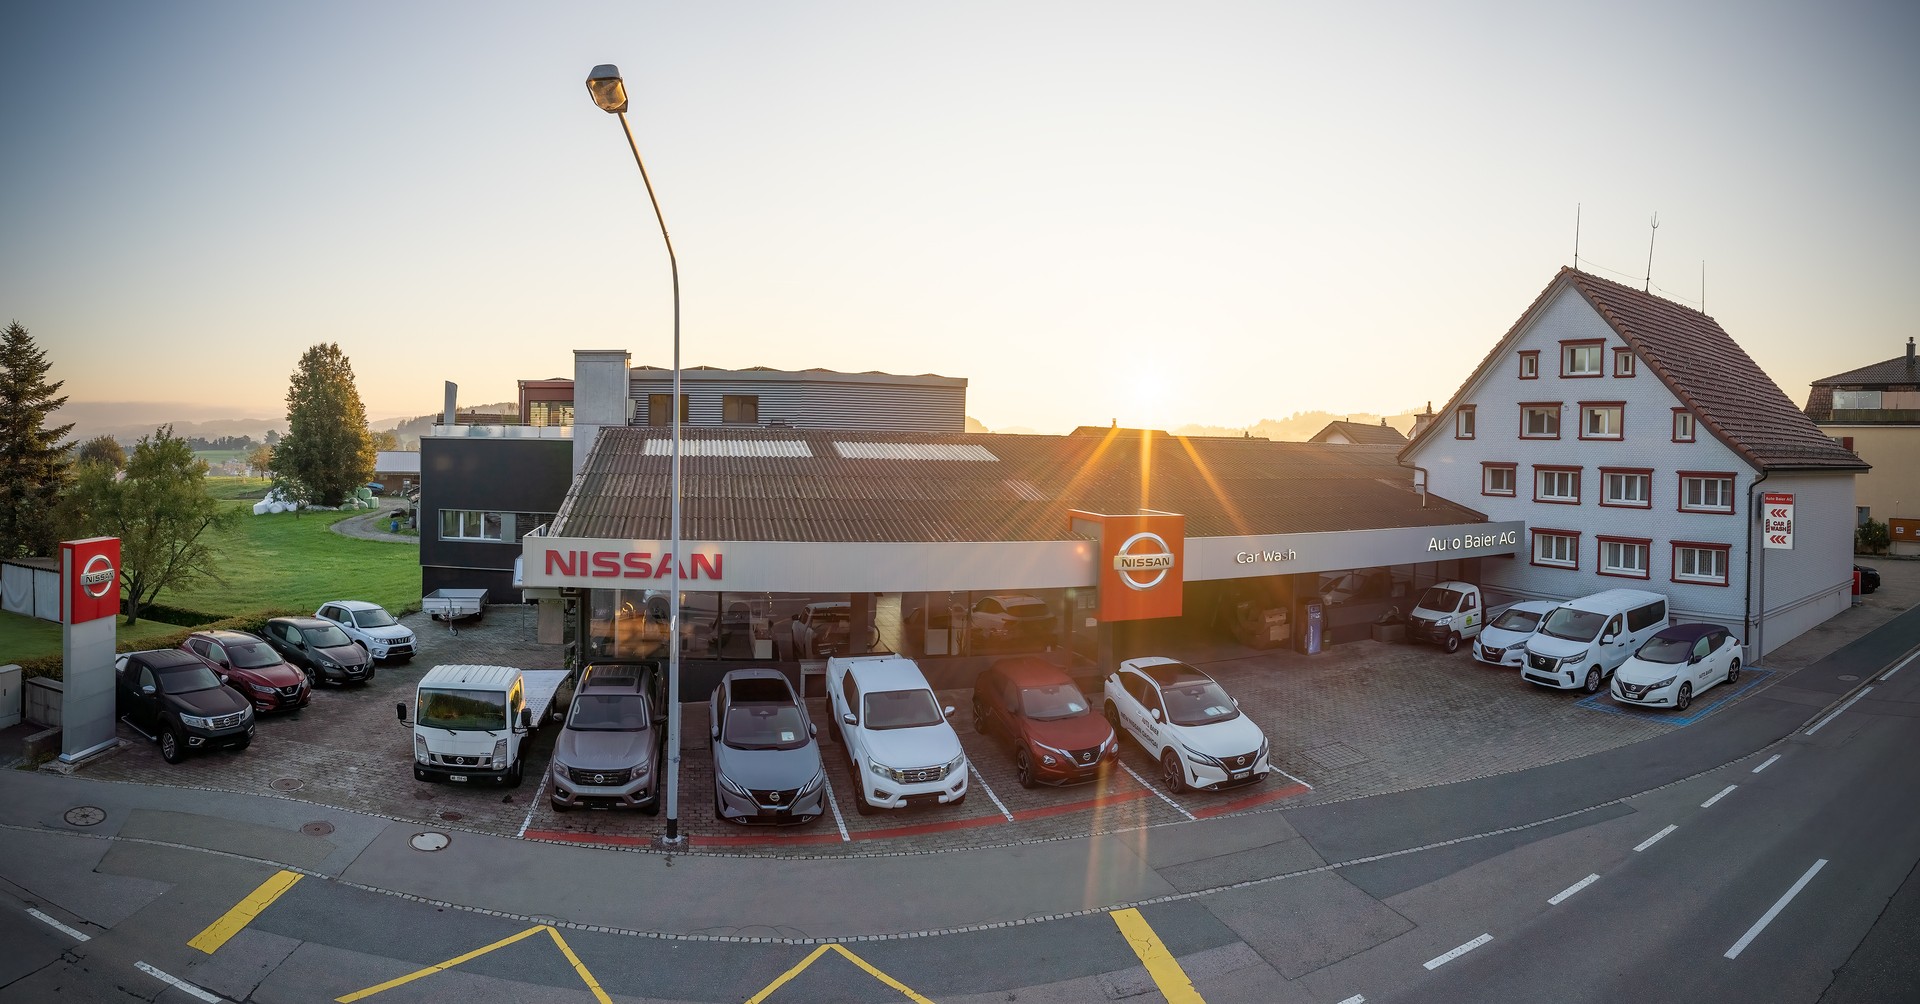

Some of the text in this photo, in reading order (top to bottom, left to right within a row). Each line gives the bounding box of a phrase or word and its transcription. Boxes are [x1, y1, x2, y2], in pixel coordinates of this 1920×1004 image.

[1427, 530, 1516, 552] Auto Baier AG
[1121, 557, 1170, 568] NISSAN
[1236, 548, 1297, 564] Car Wash
[545, 549, 723, 580] NISSAN
[85, 572, 114, 583] NISSAN
